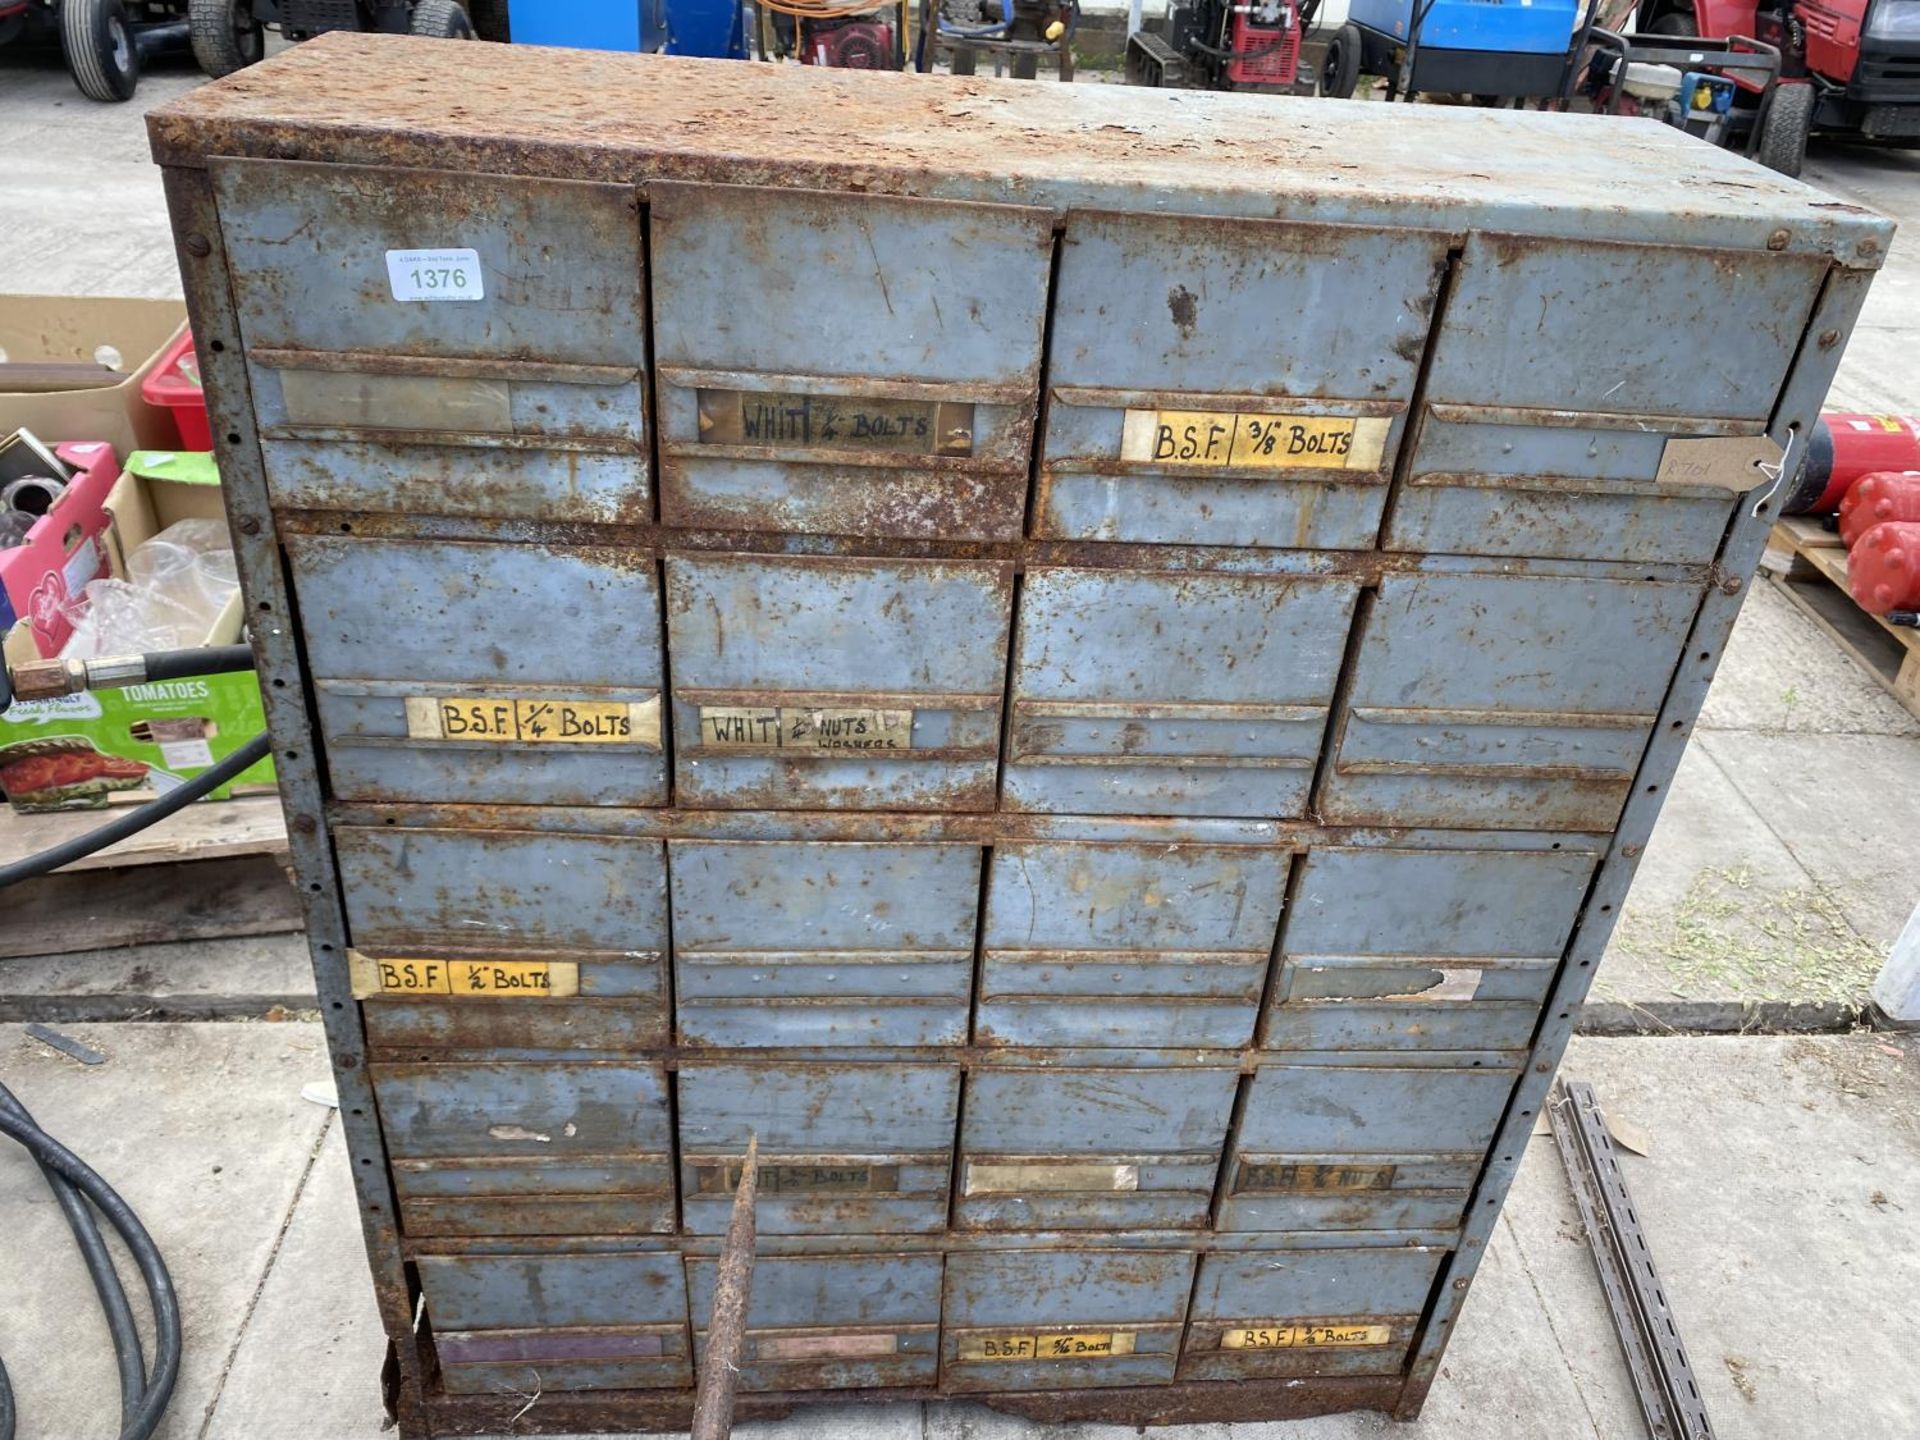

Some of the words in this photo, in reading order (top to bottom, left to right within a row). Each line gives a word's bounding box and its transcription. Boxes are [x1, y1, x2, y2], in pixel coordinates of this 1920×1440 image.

[410, 268, 467, 289] 1376
[853, 413, 929, 440] BOLTS
[1287, 425, 1352, 455] BOLTS
[120, 681, 209, 702] TOMATOES
[559, 708, 631, 737] BOLTS
[712, 711, 776, 743] WHIT
[820, 717, 866, 736] NUTS
[493, 969, 551, 989] BOLTS
